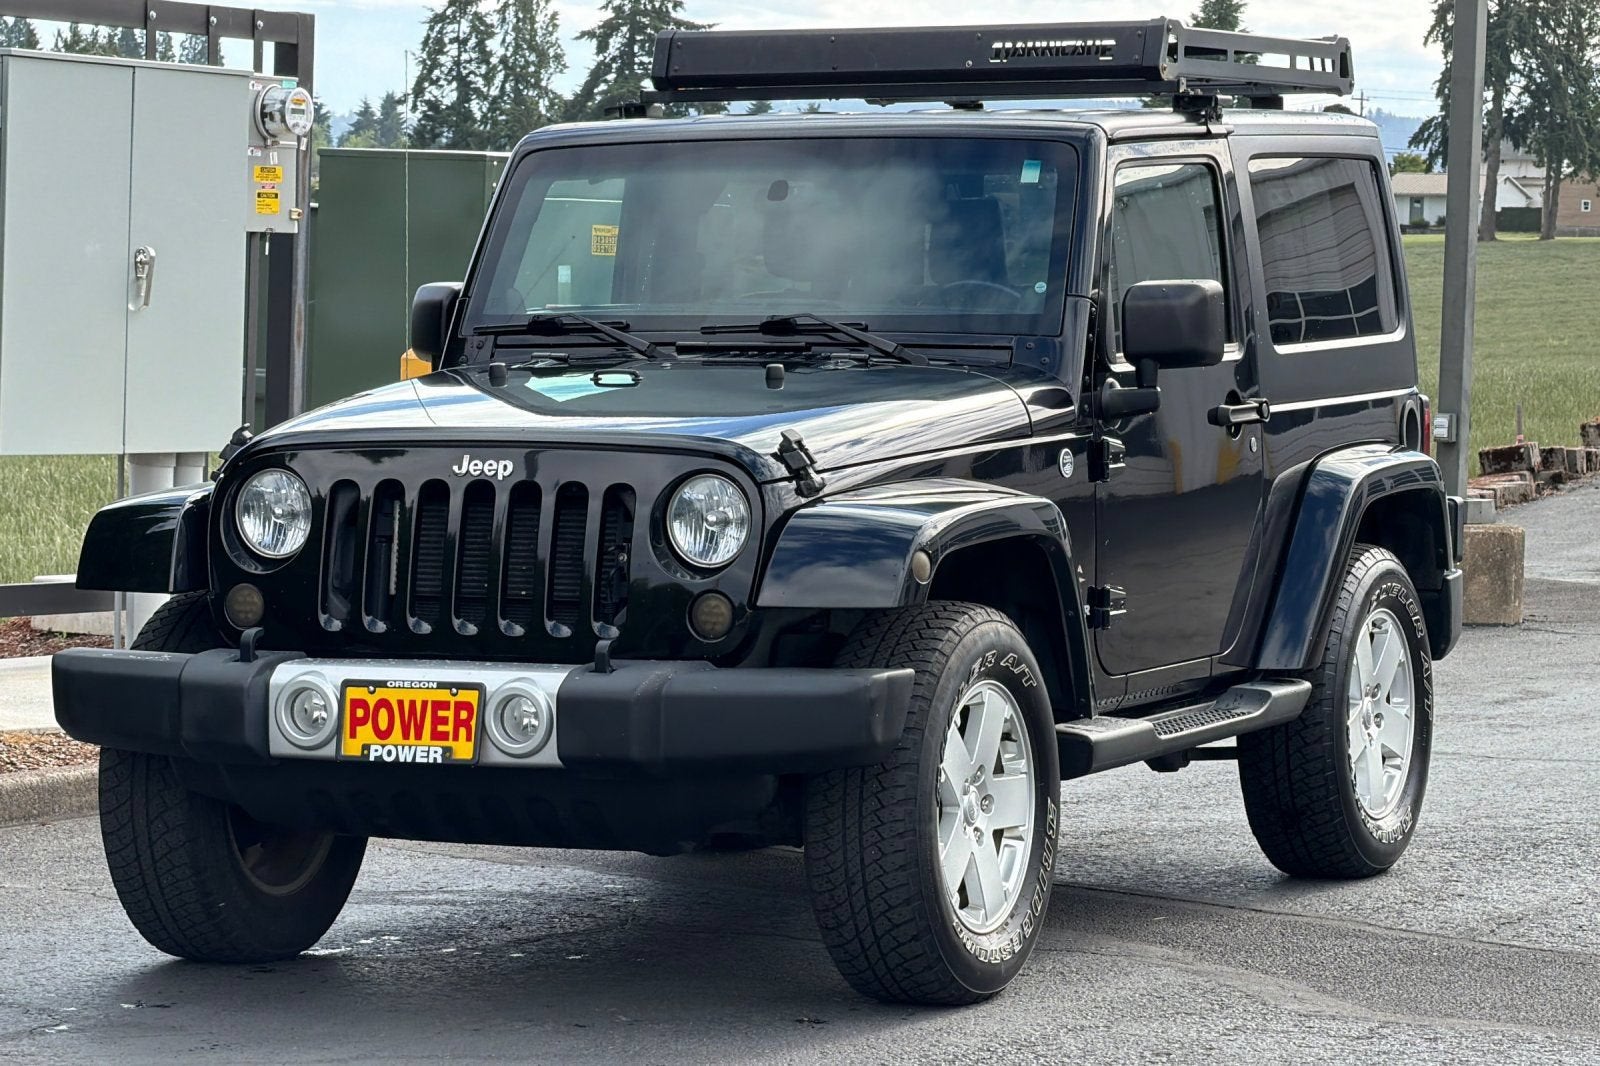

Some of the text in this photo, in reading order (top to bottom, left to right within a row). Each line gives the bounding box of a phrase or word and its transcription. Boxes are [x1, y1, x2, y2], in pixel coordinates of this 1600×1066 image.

[452, 454, 514, 480] Jeep
[1000, 653, 1037, 687] A/T
[386, 680, 438, 689] OREGON
[349, 697, 475, 742] POWER
[369, 744, 443, 763] POWER
